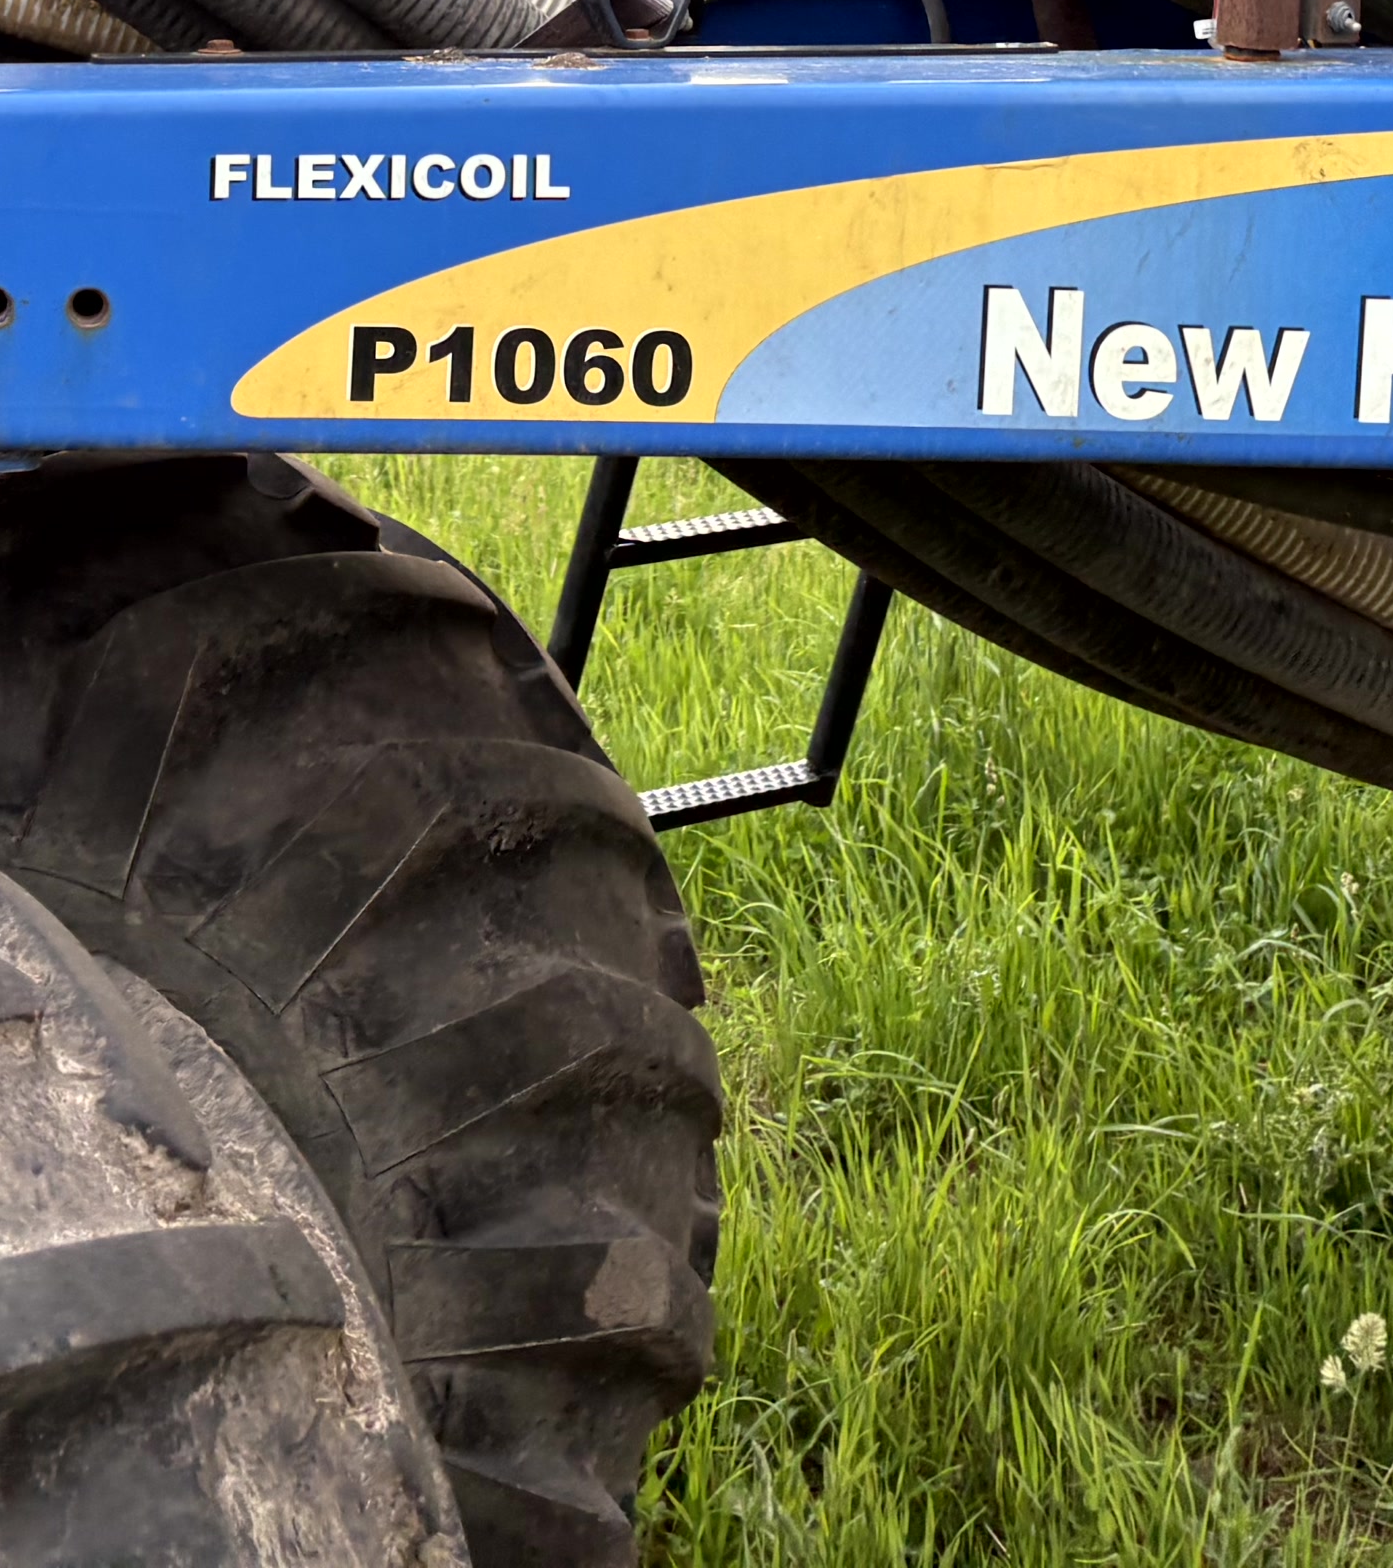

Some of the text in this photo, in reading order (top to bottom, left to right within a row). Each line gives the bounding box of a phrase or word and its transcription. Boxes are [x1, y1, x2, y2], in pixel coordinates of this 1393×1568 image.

[210, 153, 570, 201] FLEXICOIL
[348, 324, 692, 407] P1060
[978, 284, 1310, 422] New
